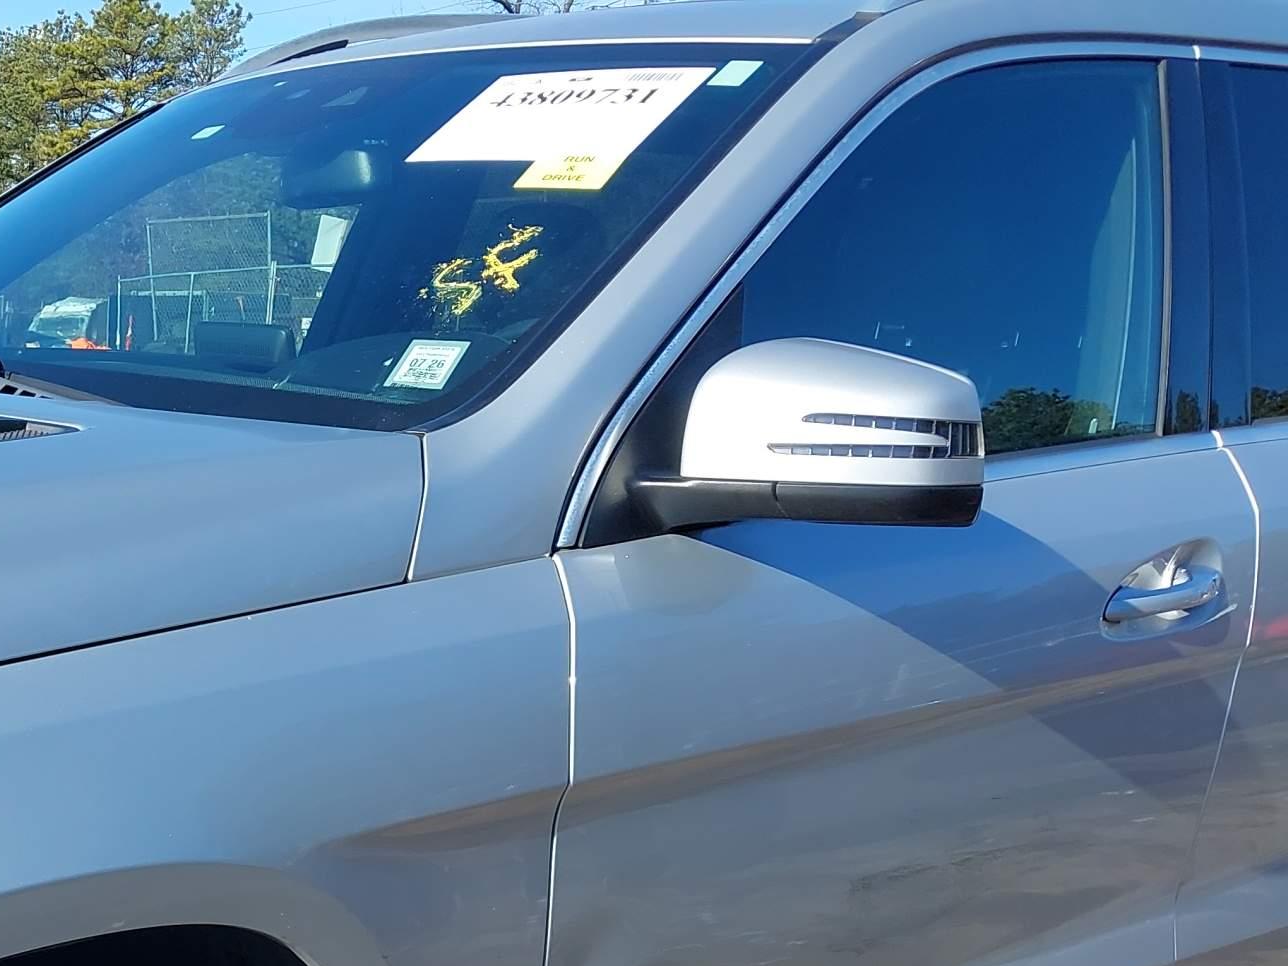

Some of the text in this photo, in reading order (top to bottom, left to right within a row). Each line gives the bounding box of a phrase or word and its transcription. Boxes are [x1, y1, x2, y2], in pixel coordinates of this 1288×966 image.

[489, 88, 660, 107] 43809731
[563, 155, 597, 163] RUN
[541, 174, 587, 182] DRIVE
[409, 358, 447, 369] 07 26
